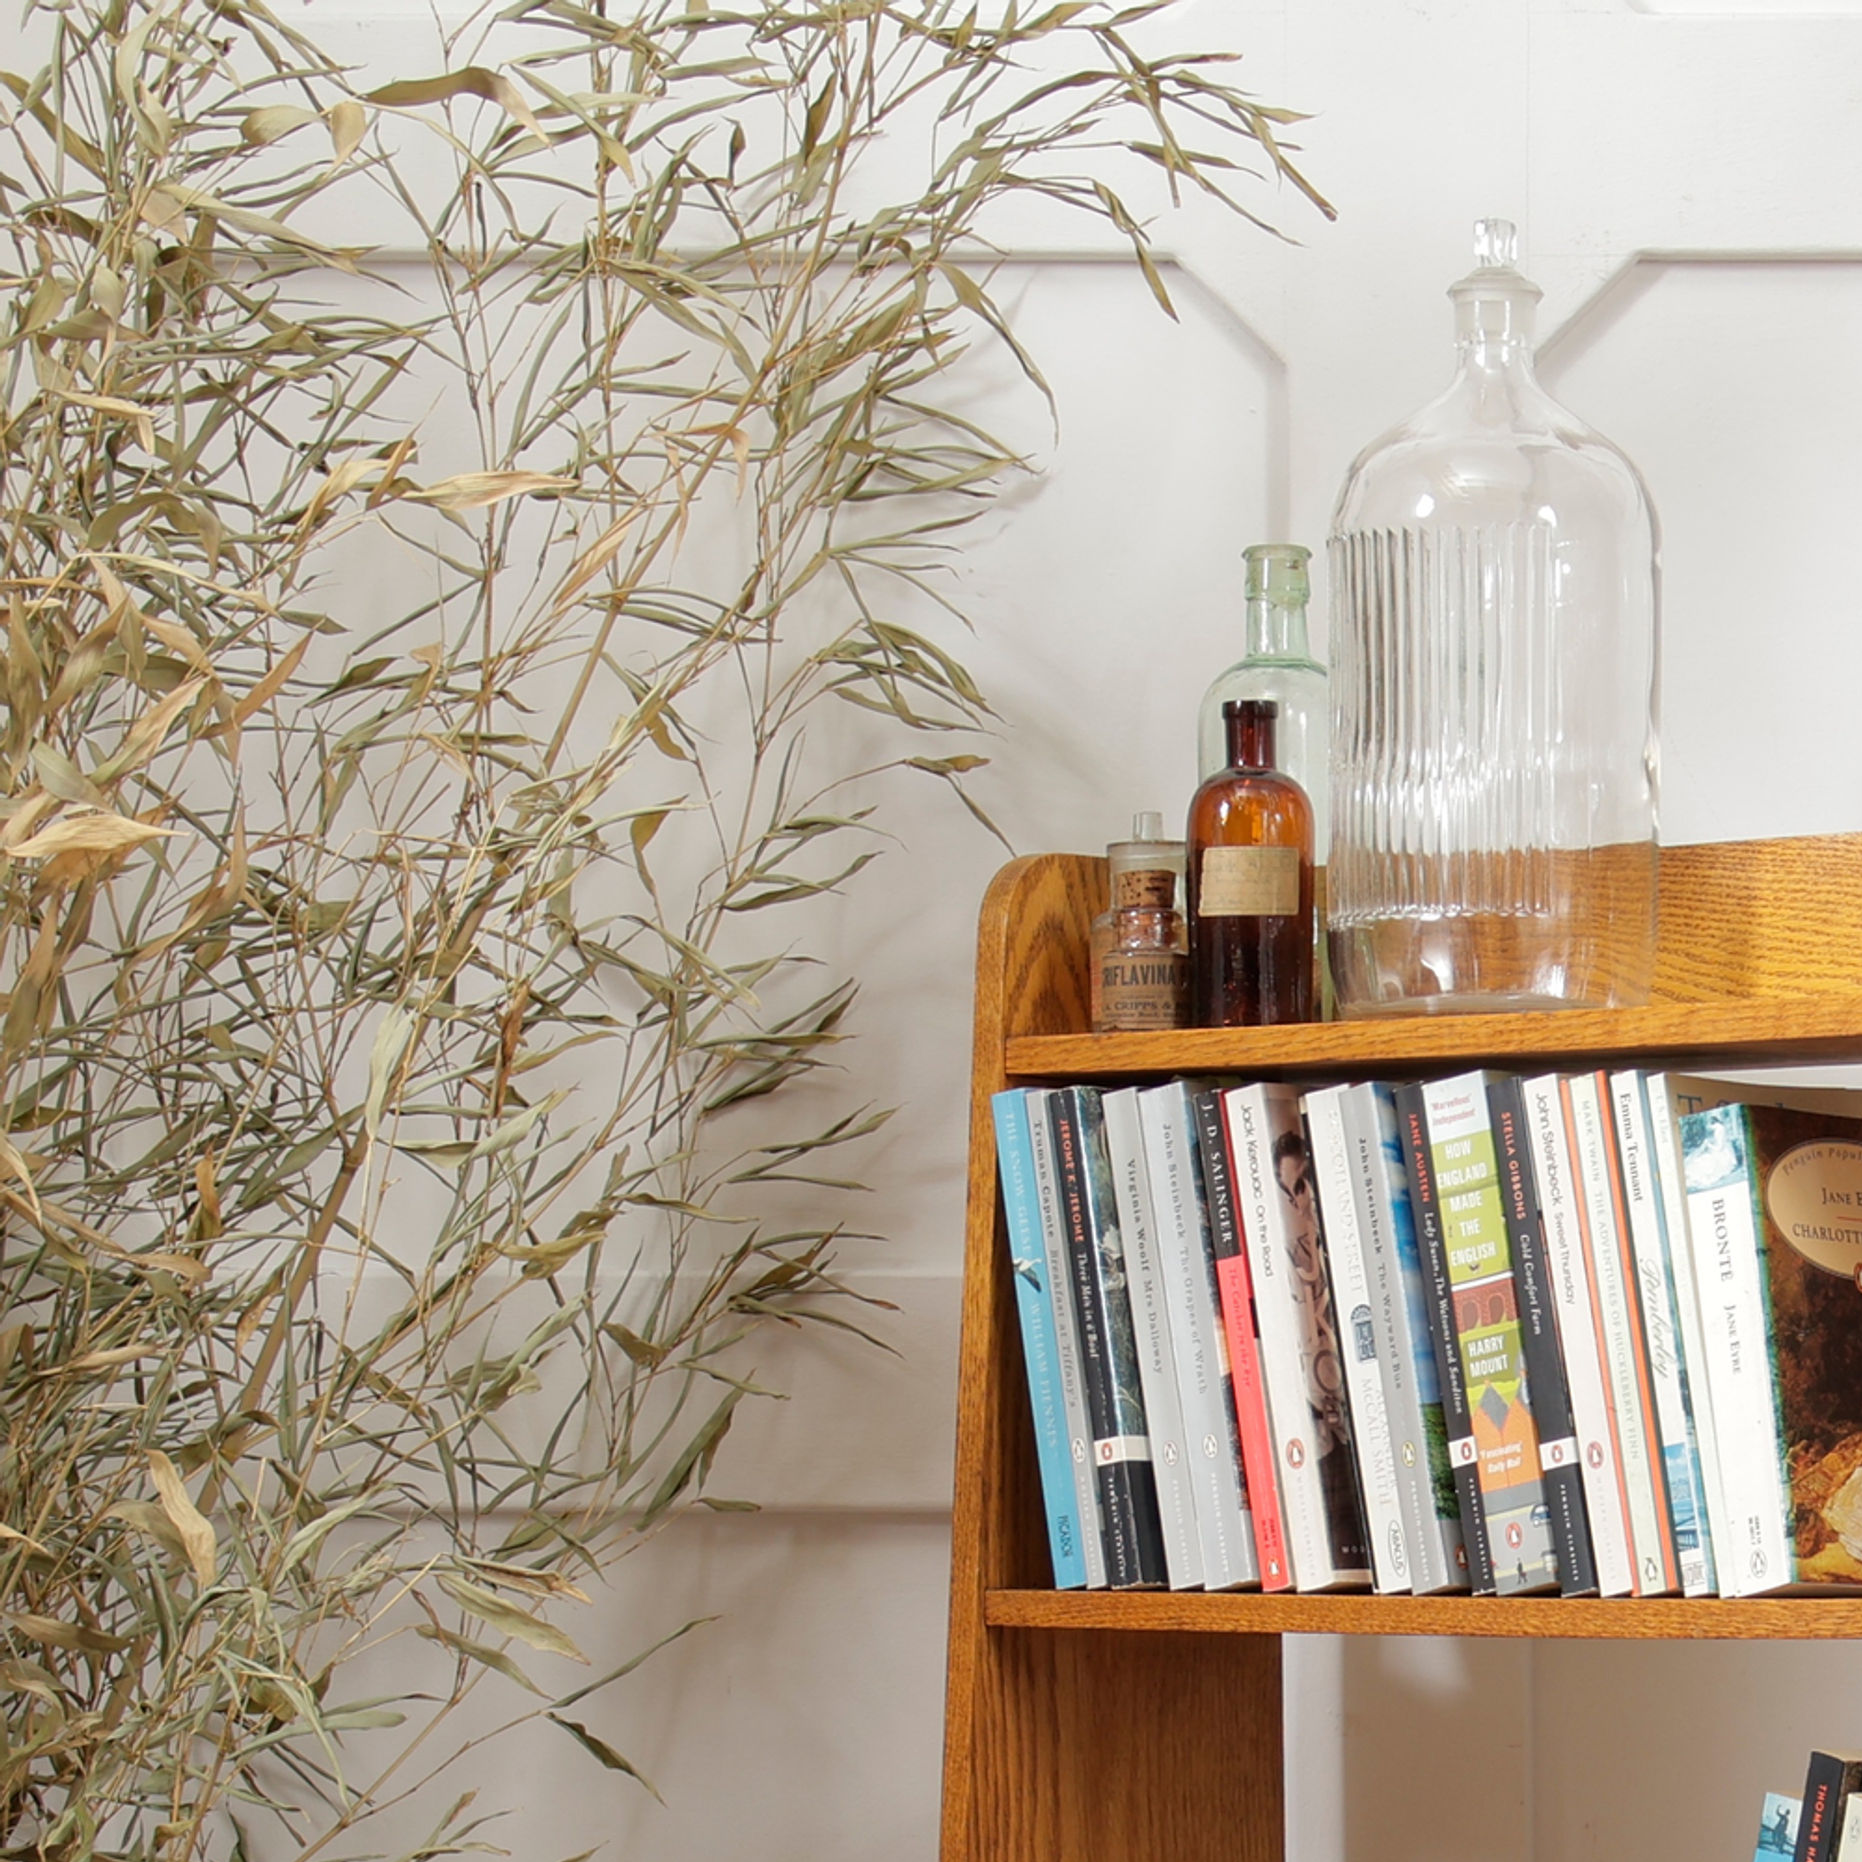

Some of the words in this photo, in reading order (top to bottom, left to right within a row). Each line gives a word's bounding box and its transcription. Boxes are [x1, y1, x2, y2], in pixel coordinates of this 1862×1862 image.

[1201, 1103, 1214, 1117] J.
[1239, 1103, 1256, 1137] Jack
[1534, 1091, 1553, 1129] John
[1580, 1100, 1594, 1136] MARK
[1619, 1092, 1636, 1139] Emma
[1161, 1122, 1175, 1159] John
[1205, 1125, 1218, 1144] D.
[1407, 1112, 1422, 1147] JANE
[1498, 1111, 1517, 1156] STELLA
[1033, 1120, 1048, 1180] Truman
[1357, 1137, 1371, 1173] John
[1445, 1139, 1472, 1159] HOW
[1586, 1140, 1601, 1181] TWAIN
[1782, 1149, 1824, 1176] Penguin
[1057, 1118, 1074, 1169] JEROME
[1068, 1191, 1084, 1243] JEROME
[1244, 1139, 1266, 1199] Kerouac
[1414, 1151, 1430, 1202] AUSTEN
[1437, 1162, 1487, 1189] ENGLAND
[1541, 1131, 1563, 1206] Steinbeck
[1625, 1141, 1644, 1202] Tennant
[1167, 1163, 1186, 1238] Steinbeck
[1208, 1151, 1234, 1243] SALINGER
[1451, 1191, 1482, 1211] MADE
[1505, 1159, 1528, 1220] GIBBONS
[1821, 1188, 1852, 1205] JANE
[1039, 1185, 1055, 1238] Capote
[1125, 1158, 1142, 1223] Virginia
[1135, 1227, 1150, 1272] Woolf
[1254, 1204, 1265, 1222] On
[1363, 1177, 1383, 1255] Steinbeck
[1421, 1212, 1435, 1238] Lady
[1460, 1219, 1481, 1237] THE
[1553, 1211, 1568, 1248] Sweet
[1257, 1224, 1268, 1243] the
[1519, 1233, 1532, 1259] Cold
[1260, 1245, 1274, 1277] Road
[1450, 1241, 1497, 1266] ENGLISH
[1142, 1279, 1155, 1307] Mrs
[1434, 1277, 1445, 1295] The
[1520, 1261, 1539, 1305] Comfort
[1557, 1249, 1576, 1305] Thursday
[1437, 1298, 1452, 1341] Watsons
[1530, 1308, 1543, 1335] Farm
[1639, 1256, 1679, 1380] Pemberley
[1145, 1312, 1165, 1374] Dalloway
[1445, 1343, 1456, 1364] and
[1468, 1335, 1504, 1356] HARRY
[1470, 1354, 1509, 1377] MOUNT
[1448, 1366, 1464, 1414] Sanditon
[1808, 1783, 1827, 1841] THOMAS
